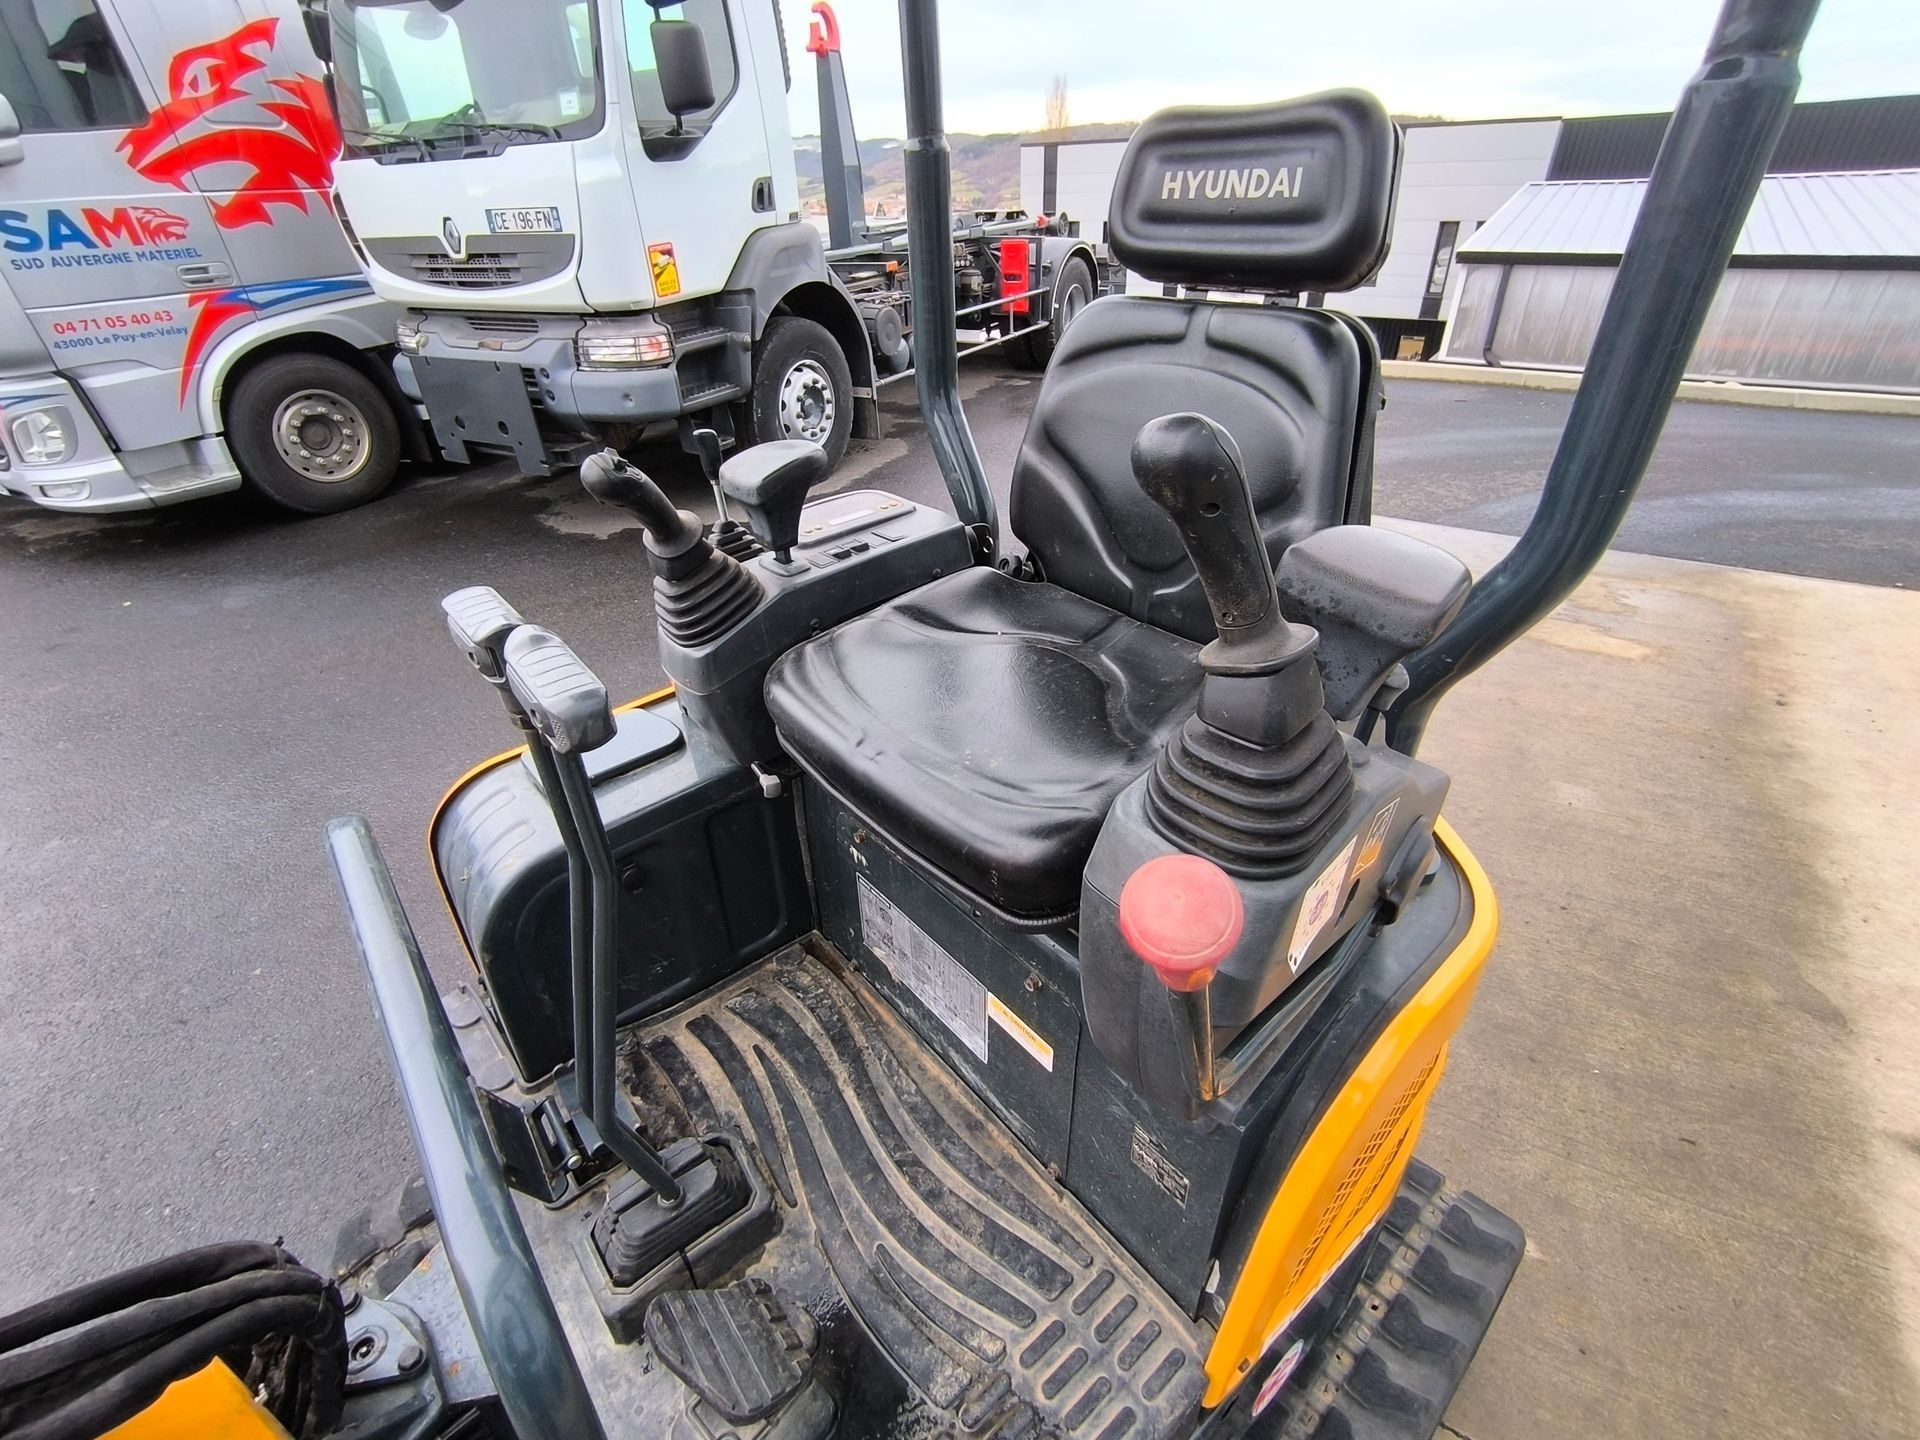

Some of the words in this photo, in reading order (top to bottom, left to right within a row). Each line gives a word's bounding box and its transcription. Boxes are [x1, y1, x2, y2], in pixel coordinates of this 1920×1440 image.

[1161, 167, 1303, 199] HYUNDAI
[0, 207, 144, 253] SAM
[11, 257, 44, 271] SUD
[52, 252, 132, 268] AUVERGNE
[137, 248, 202, 262] MATERIEL
[53, 321, 77, 335] 04
[79, 319, 101, 331] 71
[105, 316, 127, 328] 05
[131, 313, 151, 325] 40
[154, 310, 173, 322] 43
[54, 337, 94, 350] 43000
[95, 334, 110, 345] Le
[112, 326, 188, 342] Puy-en-Velay
